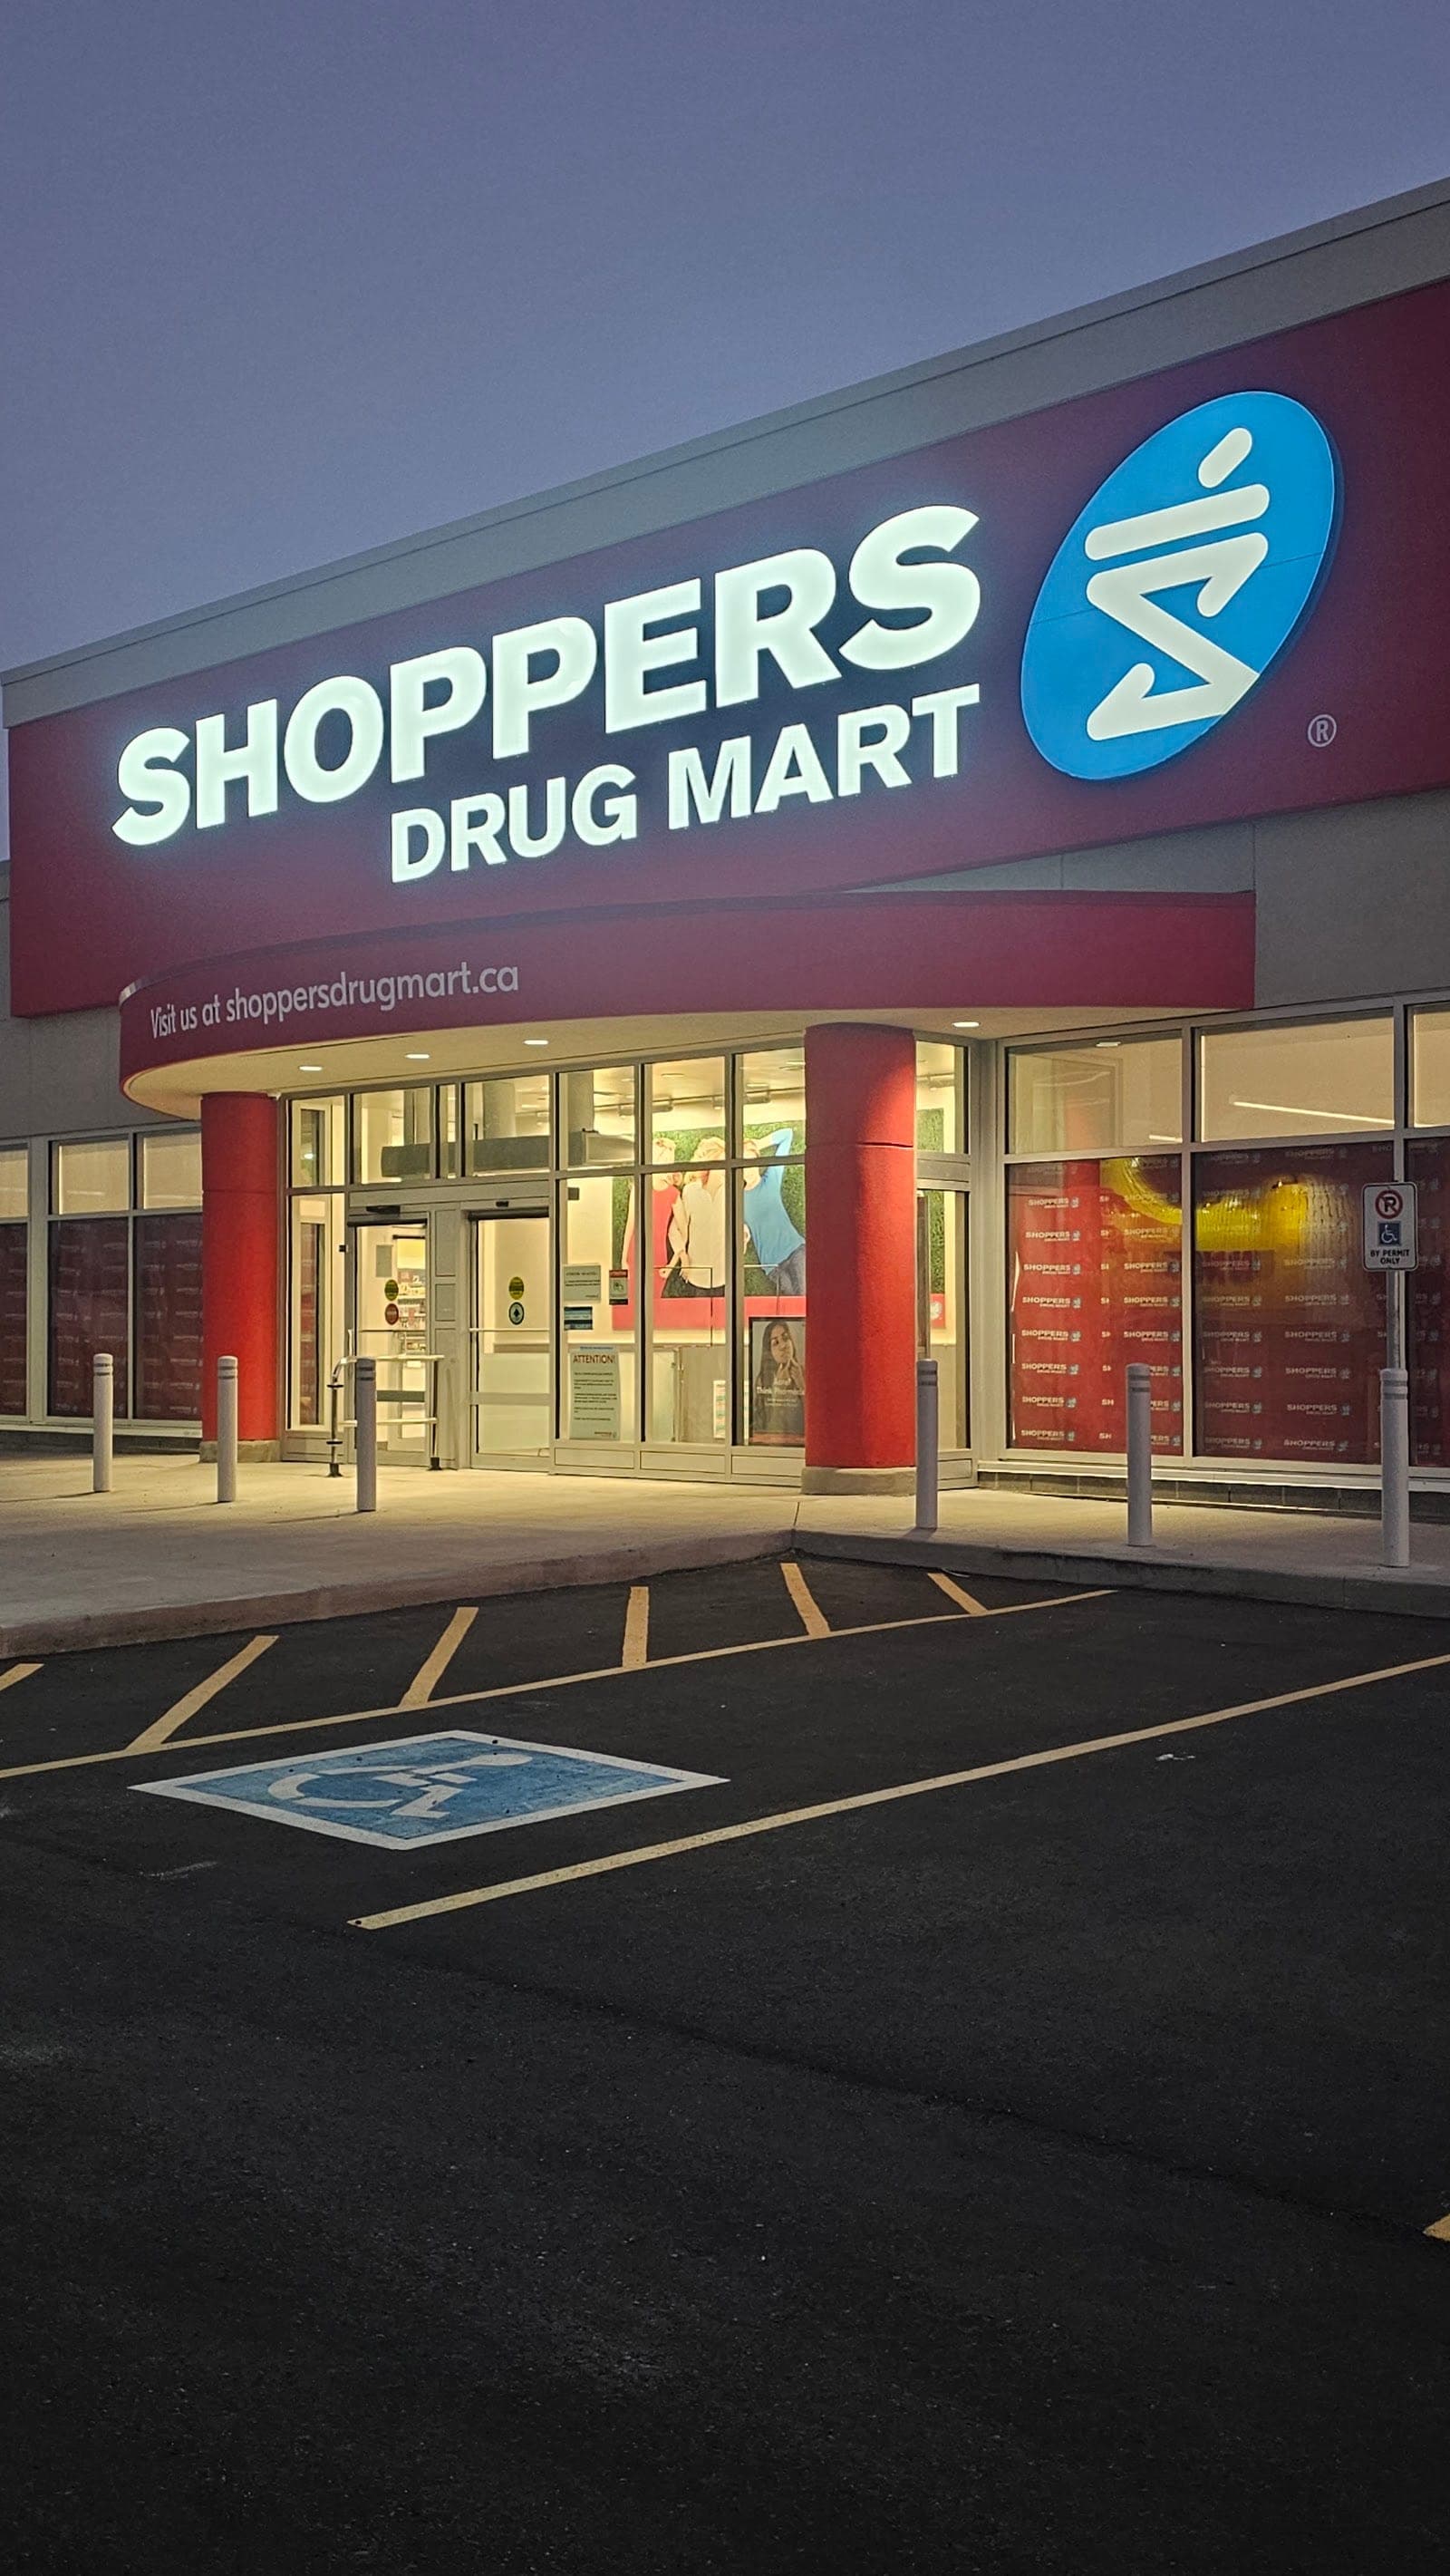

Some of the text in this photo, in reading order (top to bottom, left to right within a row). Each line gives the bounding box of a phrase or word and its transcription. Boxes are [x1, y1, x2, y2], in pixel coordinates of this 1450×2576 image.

[111, 504, 981, 846] SHOPPERS
[391, 683, 980, 884] DRUG MART
[150, 962, 519, 1039] Visit us at shoppersdrugmart.ca
[1029, 1197, 1069, 1206] SHOPPERS
[1025, 1231, 1070, 1239] SHOPPERS
[1124, 1262, 1168, 1270] SHOPPERS
[1284, 1331, 1337, 1339] SHOPPERS
[1285, 1367, 1337, 1375] SHOPPERS
[1022, 1396, 1065, 1404] SHOPPERS
[1020, 1429, 1064, 1438] SHOPPERS
